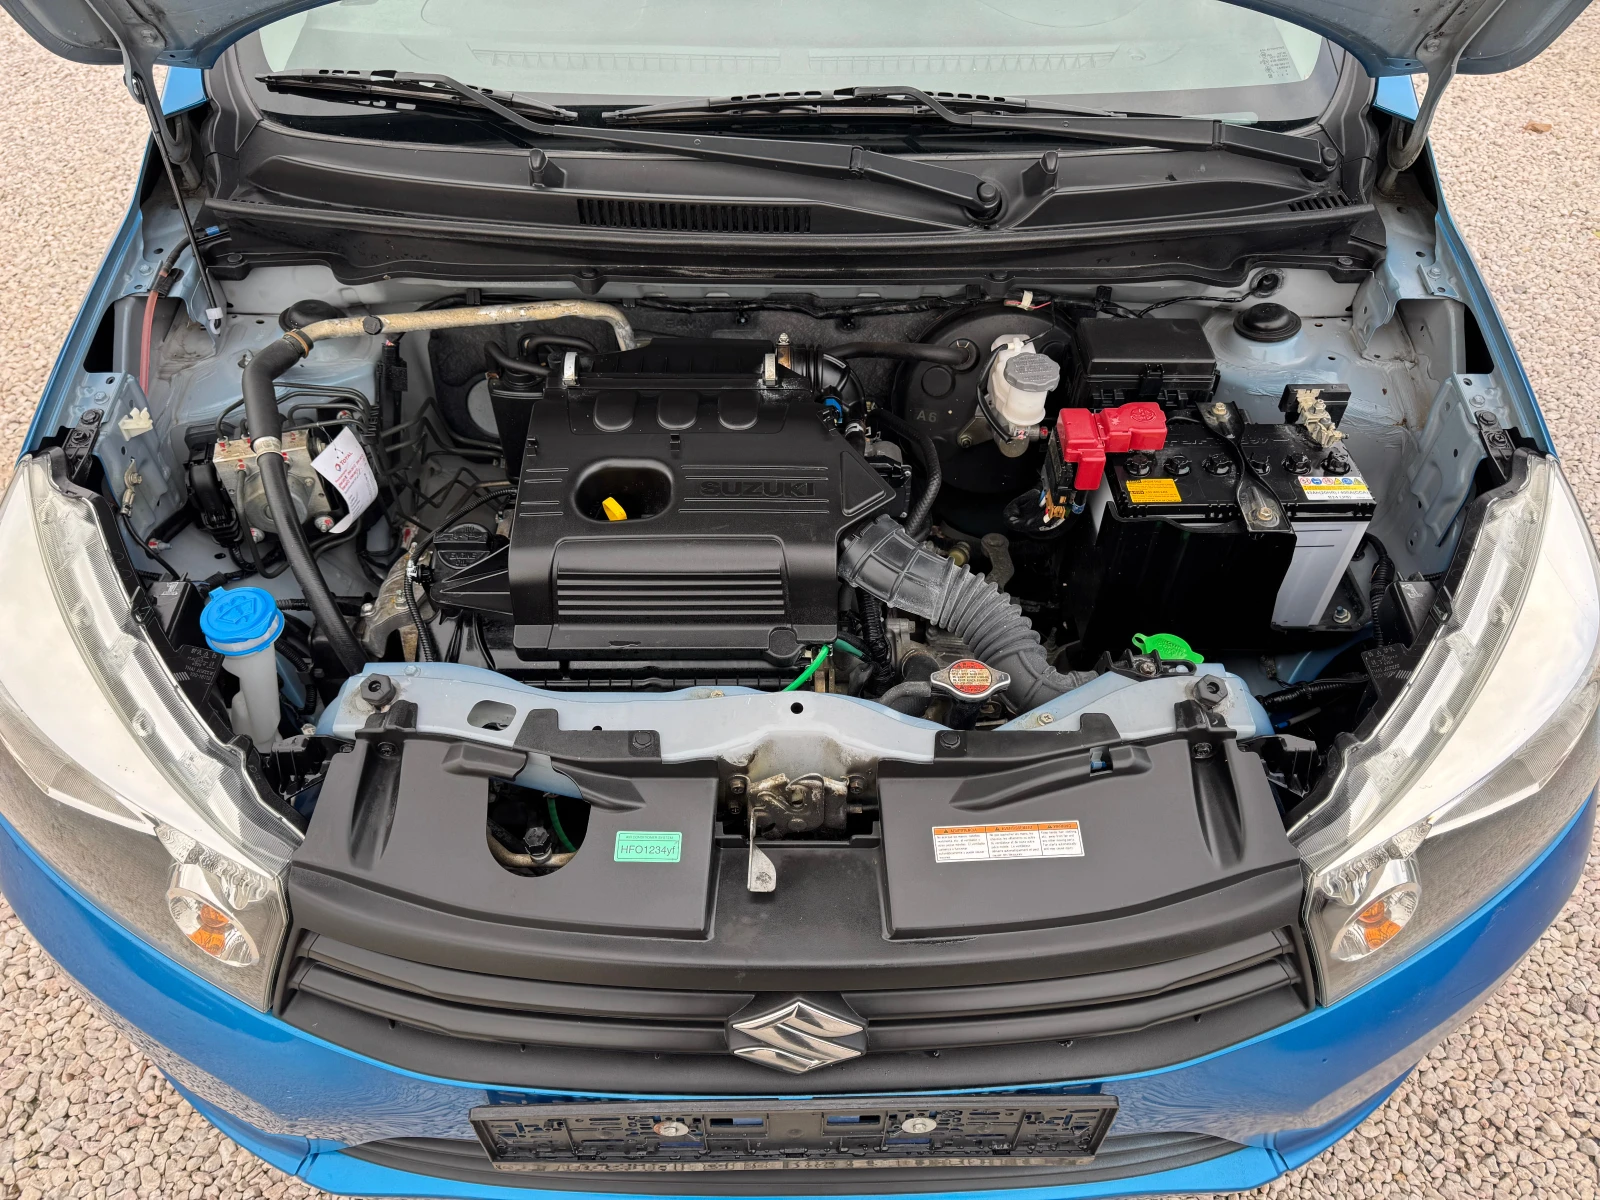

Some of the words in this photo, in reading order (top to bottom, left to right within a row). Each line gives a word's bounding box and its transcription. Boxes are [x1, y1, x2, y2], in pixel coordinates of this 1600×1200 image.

[339, 452, 354, 466] TOTAL
[700, 481, 816, 497] SUZUKI
[620, 845, 676, 857] HFO1234yf
